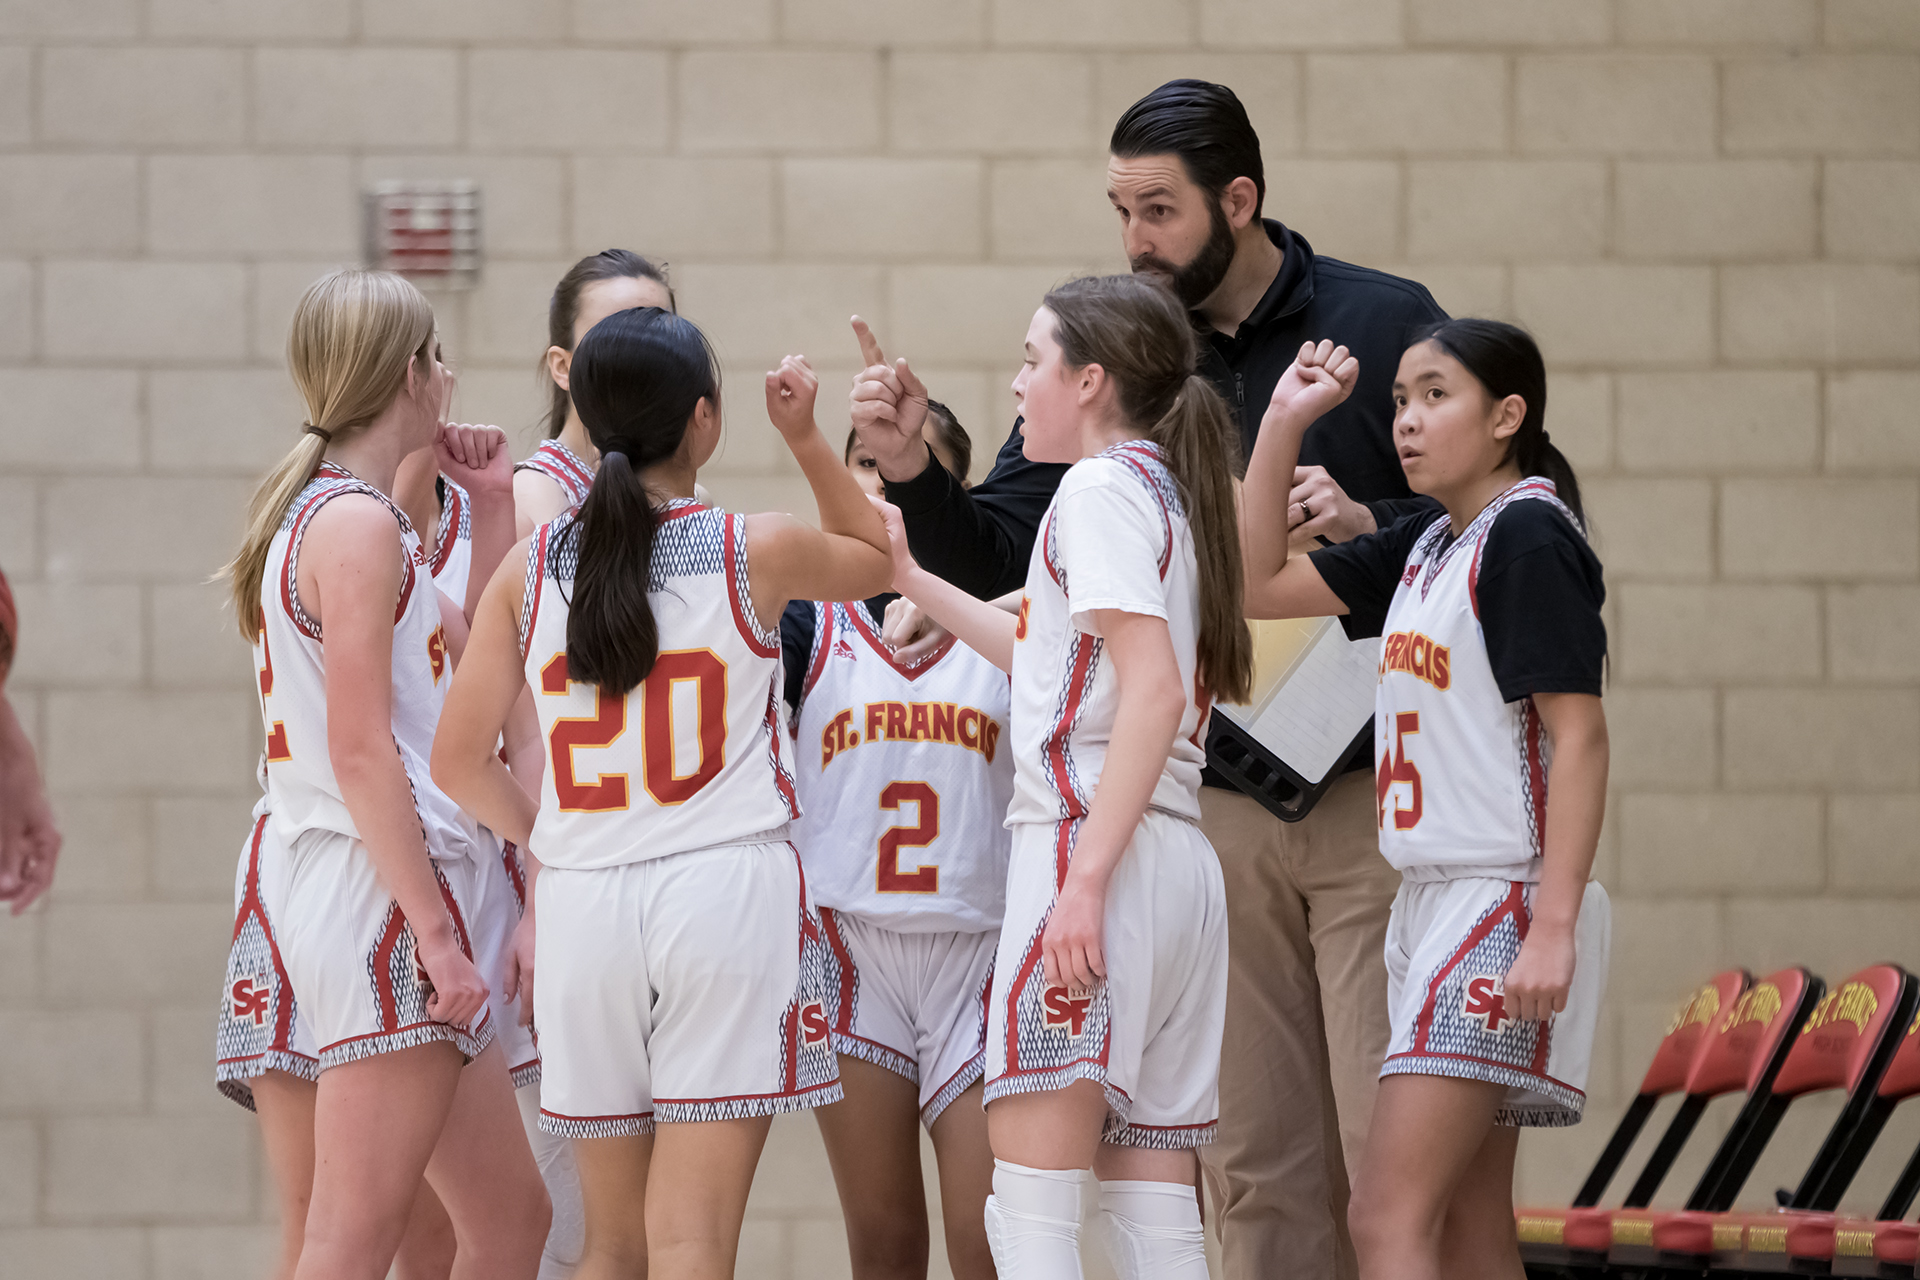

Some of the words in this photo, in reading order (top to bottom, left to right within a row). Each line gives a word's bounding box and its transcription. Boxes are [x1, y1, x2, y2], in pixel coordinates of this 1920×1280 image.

[540, 647, 728, 813] 20
[822, 706, 860, 773] ST.
[865, 700, 999, 765] FRANCIS
[876, 780, 939, 894] 2
[230, 974, 272, 1029] SF
